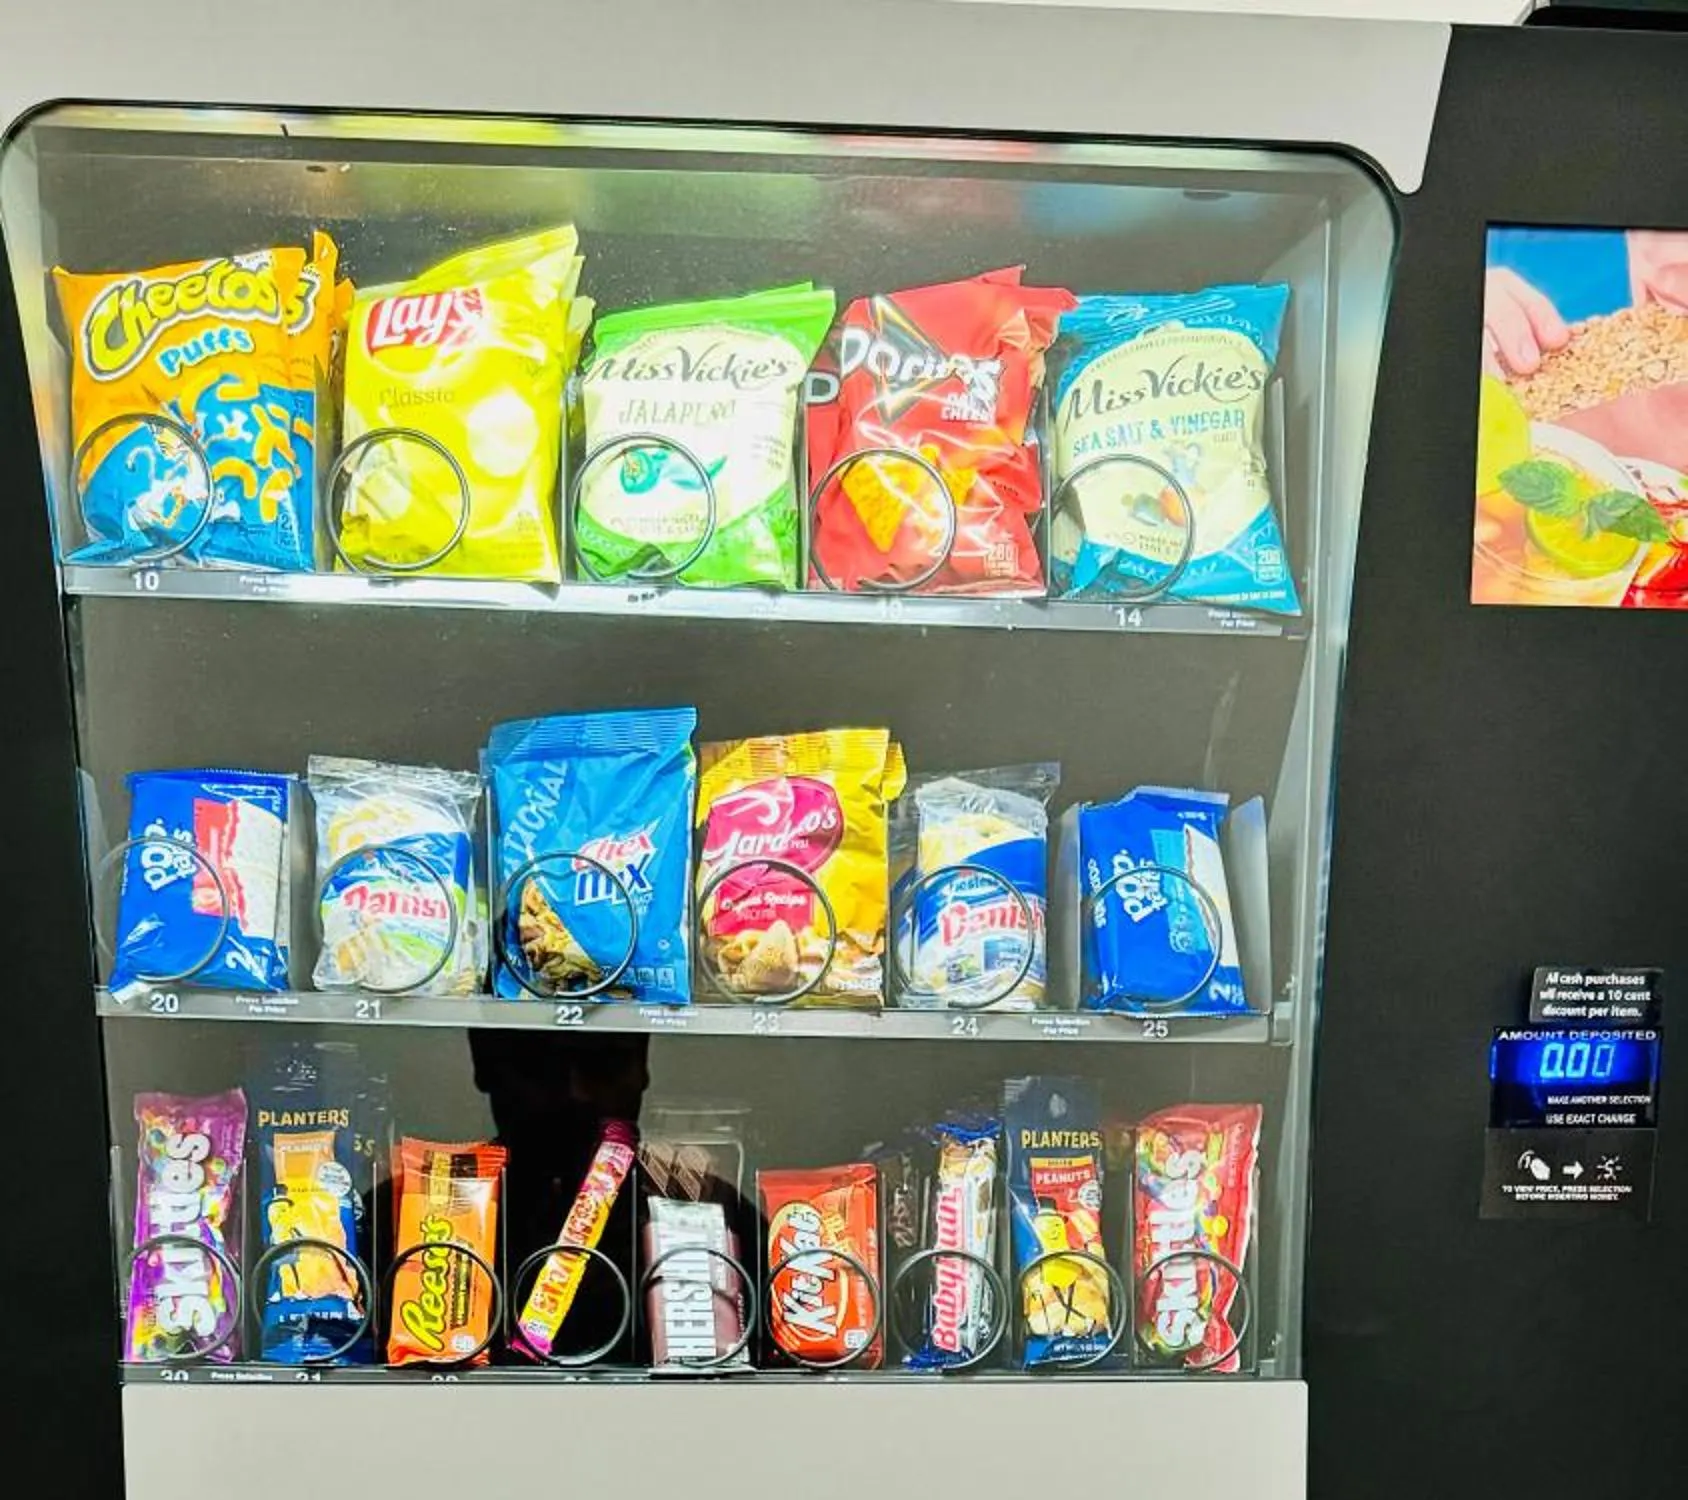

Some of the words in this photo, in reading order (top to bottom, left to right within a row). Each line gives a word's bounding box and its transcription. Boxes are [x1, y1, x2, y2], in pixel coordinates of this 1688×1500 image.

[84, 256, 281, 378] Cheetos
[584, 358, 676, 384] Miss
[677, 343, 789, 391] Vickie's
[1063, 379, 1145, 435] Miss
[1142, 354, 1264, 402] Vickie's
[1073, 434, 1102, 456] SEA
[1150, 419, 1165, 440] &
[1170, 409, 1246, 436] VINEGAR
[133, 572, 160, 591] 10
[1115, 608, 1143, 628] 14
[1545, 973, 1560, 985] All
[1560, 973, 1583, 985] cash
[1585, 972, 1646, 987] purchases
[151, 994, 179, 1013] 20
[1539, 989, 1557, 1001] will
[1557, 990, 1595, 1001] receive
[1597, 992, 1605, 1001] a
[1608, 990, 1623, 1001] 10
[1624, 990, 1652, 1002] cent
[355, 999, 382, 1019] 21
[557, 1006, 585, 1025] 22
[1542, 1005, 1587, 1017] discount
[1588, 1007, 1610, 1019] per
[1611, 1005, 1643, 1017] item.
[753, 1011, 780, 1034] 23
[952, 1018, 979, 1037] 24
[1143, 1021, 1168, 1038] 25
[1498, 1030, 1564, 1041] AMOUNT
[1569, 1030, 1657, 1041] DEPOSITED
[1609, 1095, 1652, 1105] SELECTION
[257, 1109, 350, 1128] PLANTERS
[1546, 1113, 1564, 1125] USE
[1566, 1113, 1596, 1125] EXACT
[1598, 1113, 1637, 1125] CHANGE
[1020, 1129, 1101, 1149] PLANTERS
[1035, 1170, 1091, 1184] PEANUTS
[149, 1132, 217, 1338] Skittles
[1148, 1149, 1208, 1348] Skittles
[399, 1214, 454, 1352] Reese's
